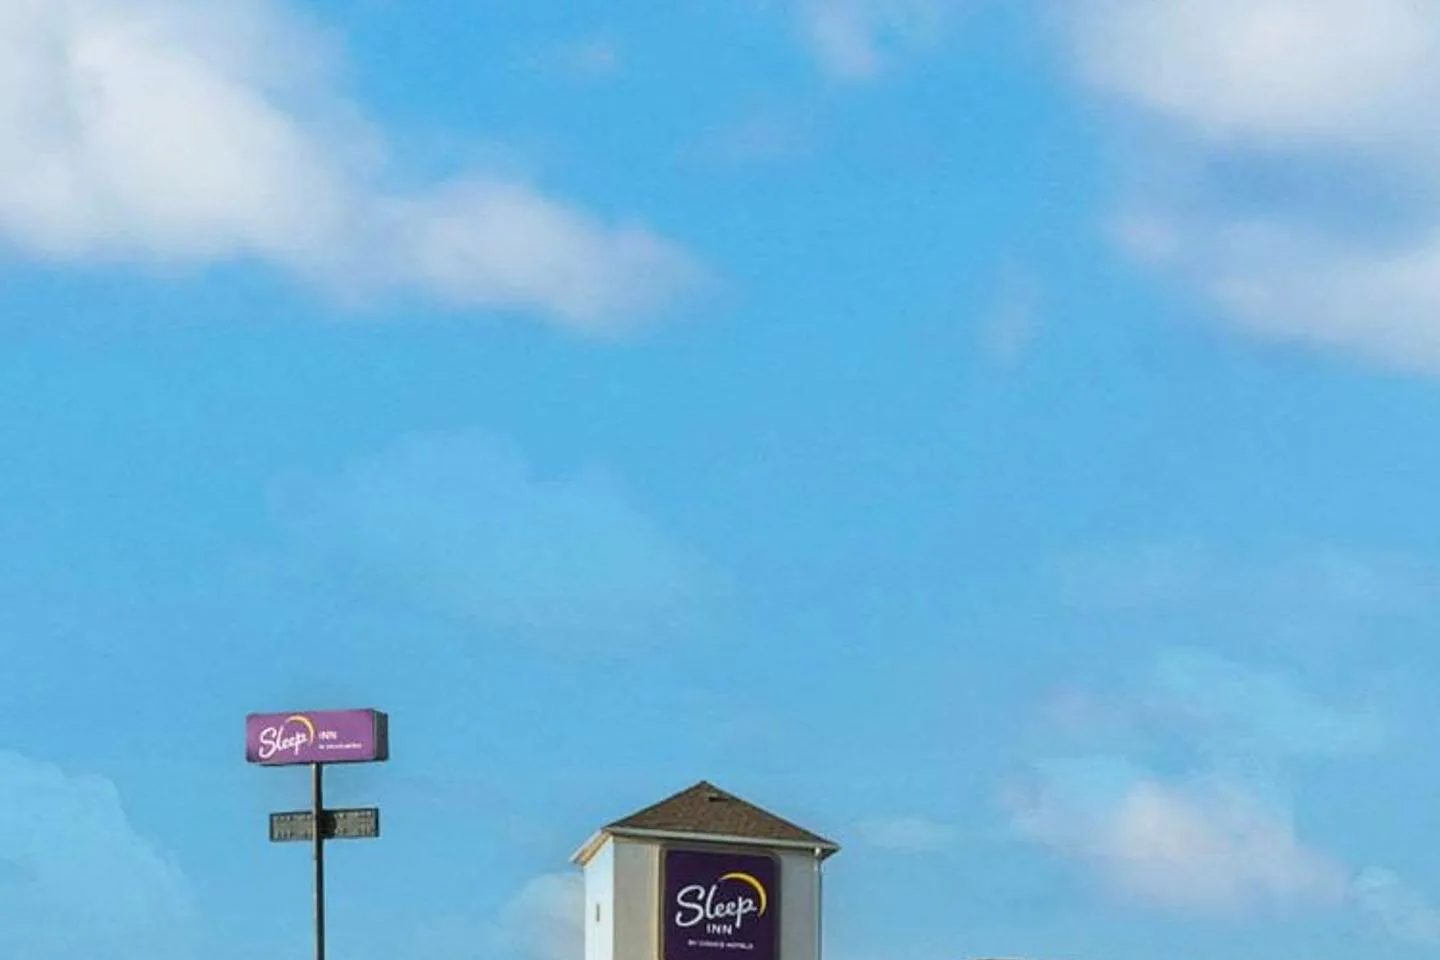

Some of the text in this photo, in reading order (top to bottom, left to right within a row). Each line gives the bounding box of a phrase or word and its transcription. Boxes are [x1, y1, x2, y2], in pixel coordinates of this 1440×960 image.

[258, 726, 308, 759] Sleep
[675, 884, 757, 928] Sleep
[706, 923, 733, 935] INN
